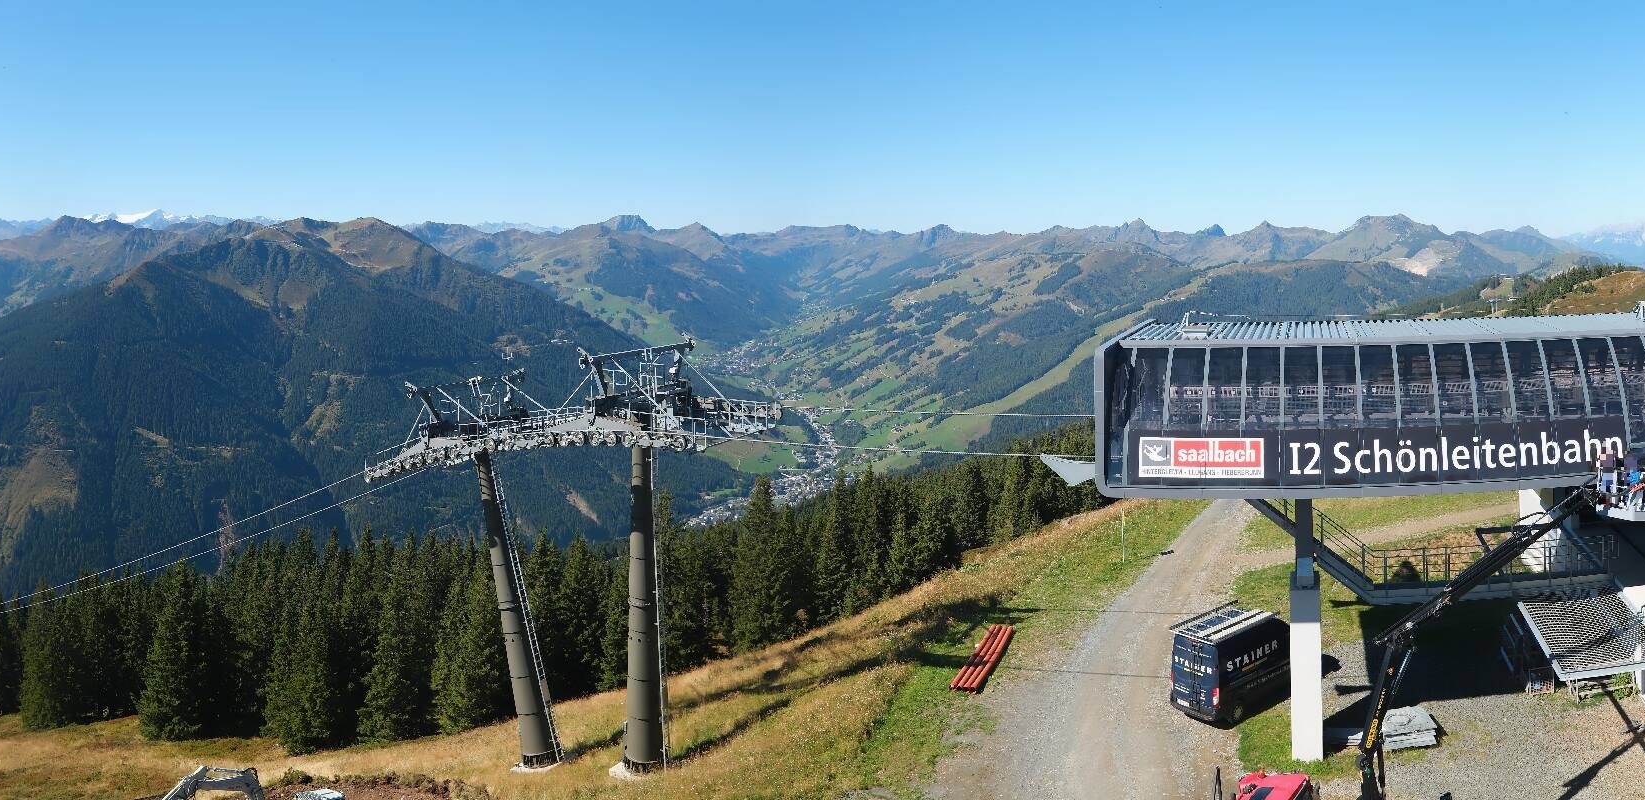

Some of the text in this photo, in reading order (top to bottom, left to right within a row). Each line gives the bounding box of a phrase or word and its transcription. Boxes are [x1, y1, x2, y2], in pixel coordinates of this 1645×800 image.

[1177, 439, 1256, 463] saalbach
[1289, 429, 1624, 475] I2 Schönleitenbahn
[1174, 655, 1213, 675] STAINER
[1226, 639, 1278, 672] STAINER
